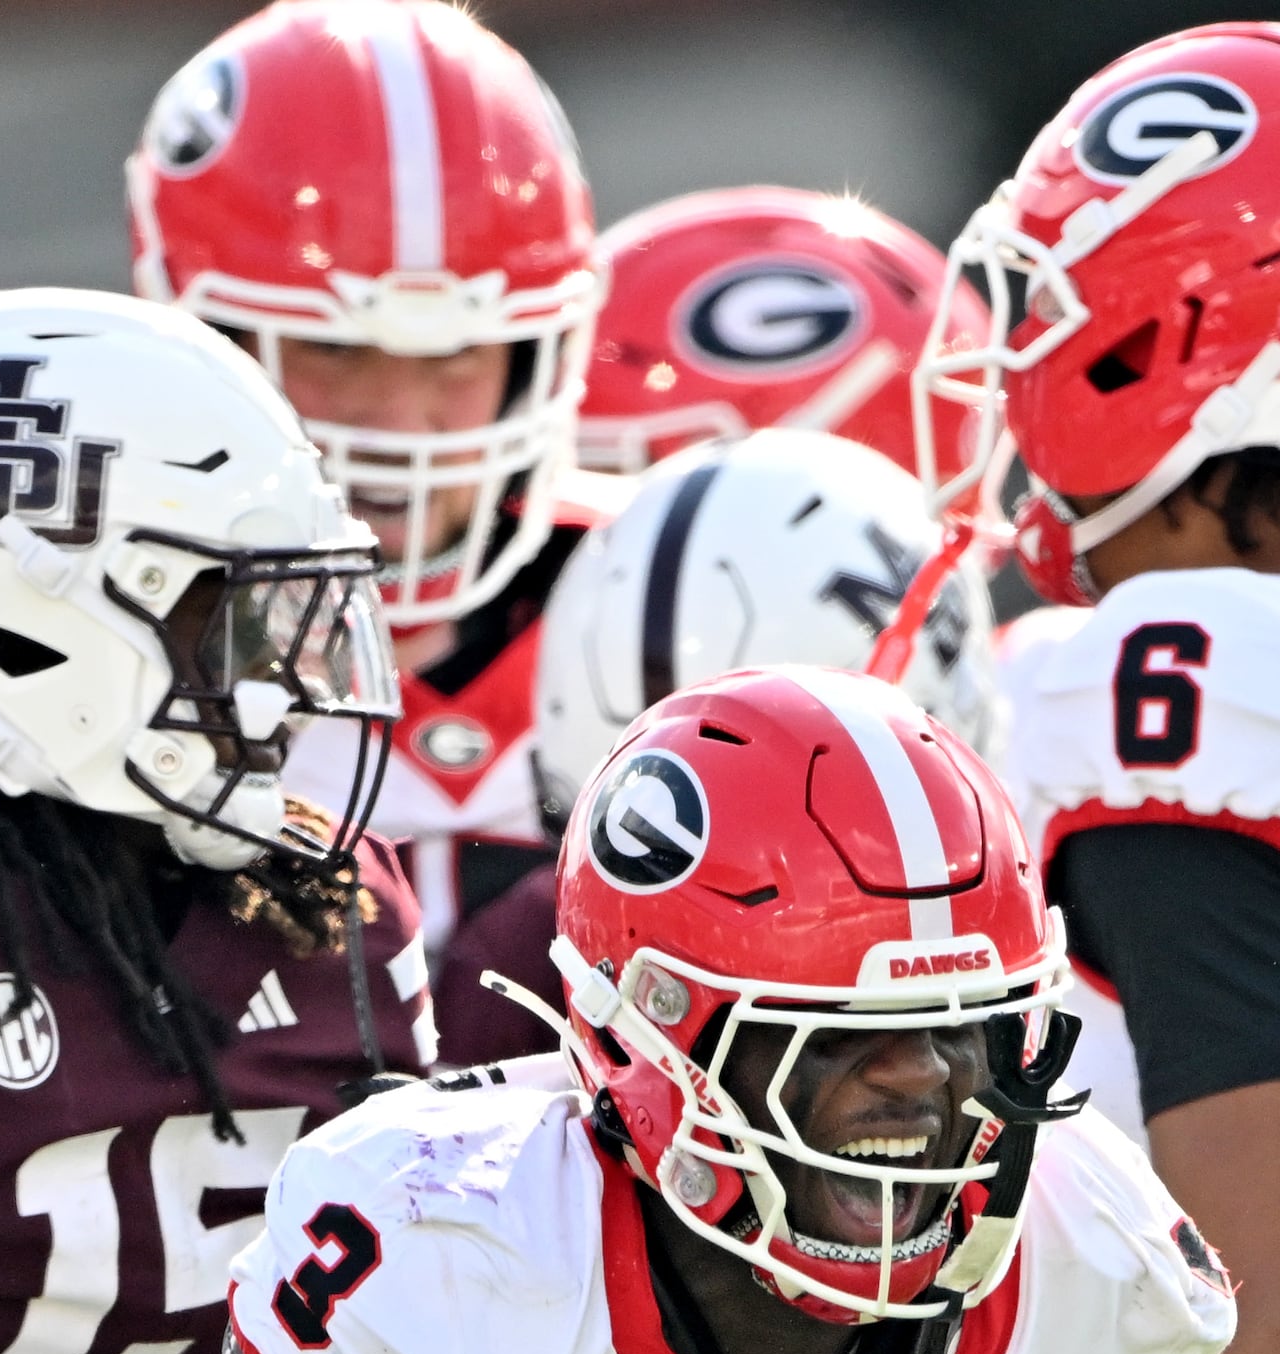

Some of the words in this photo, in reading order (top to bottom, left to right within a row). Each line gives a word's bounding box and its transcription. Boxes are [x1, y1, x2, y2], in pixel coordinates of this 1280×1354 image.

[1076, 76, 1255, 180] G
[684, 262, 863, 364] G
[1112, 621, 1212, 771] 6
[588, 750, 708, 889] G
[889, 950, 991, 979] DAWGS
[271, 1202, 382, 1350] 3
